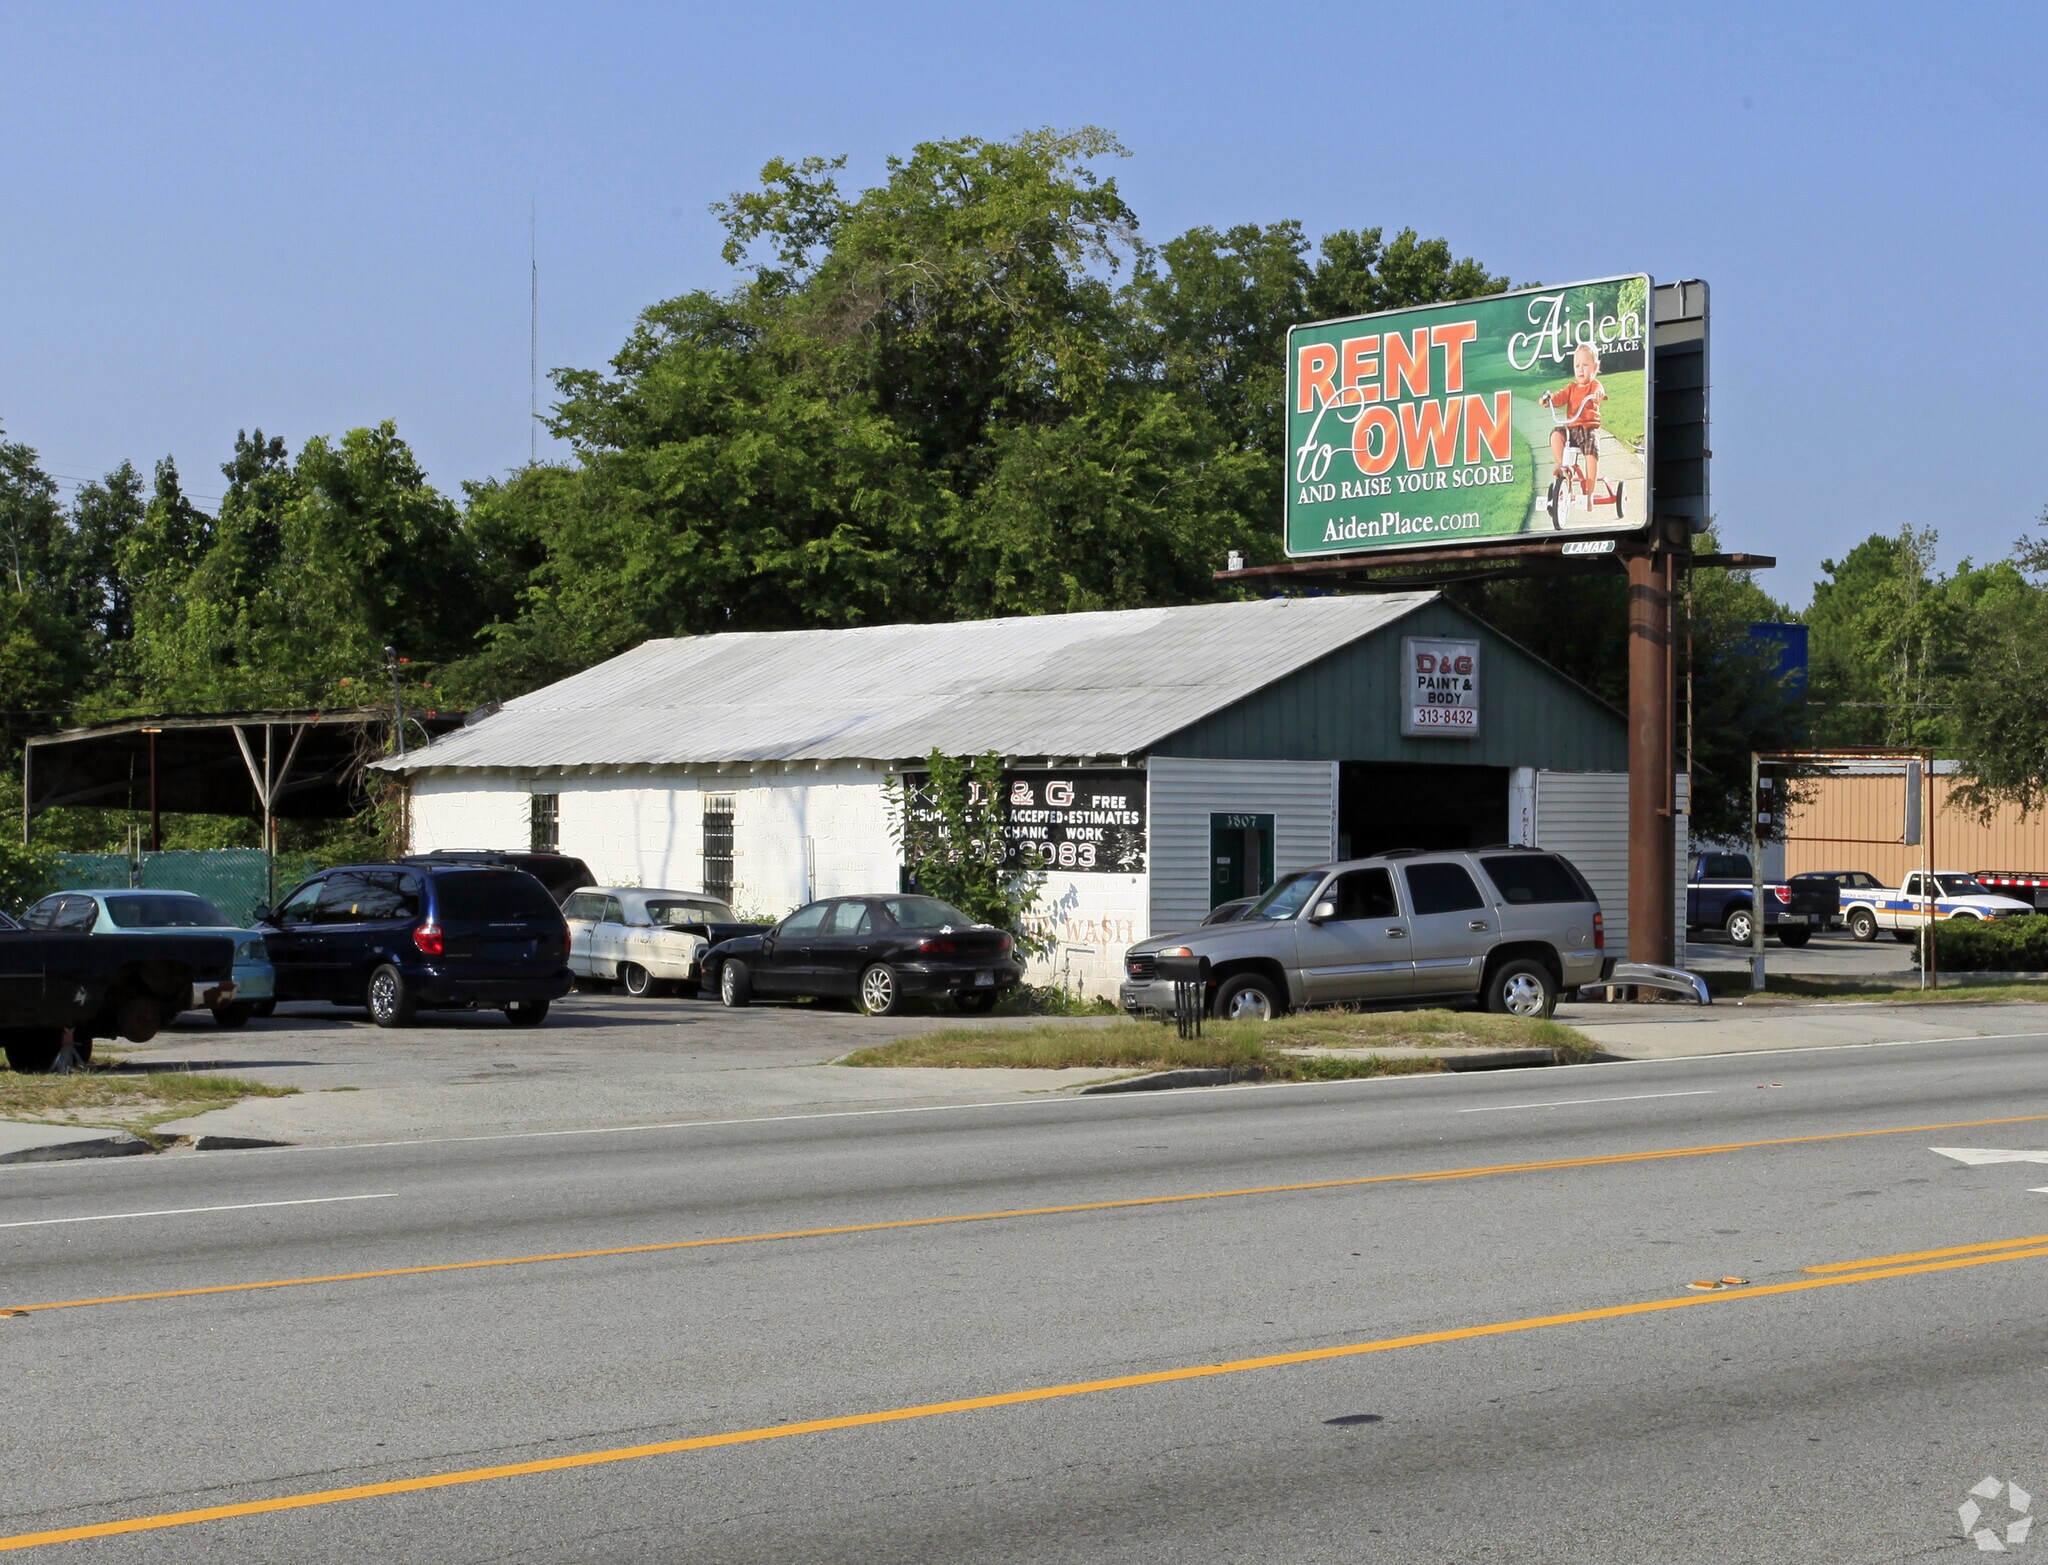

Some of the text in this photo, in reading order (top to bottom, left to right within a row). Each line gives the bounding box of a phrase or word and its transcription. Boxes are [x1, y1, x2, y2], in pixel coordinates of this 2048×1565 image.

[1508, 291, 1642, 371] Aiden
[1602, 340, 1640, 355] PLACE
[1297, 319, 1477, 414] RENT
[1296, 386, 1374, 484] to
[1351, 390, 1513, 476] OWN
[1297, 464, 1514, 505] AND RAISE YOUR SCORE
[1322, 510, 1481, 543] AidenPlace.com
[1568, 541, 1609, 554] LAMAR
[1417, 675, 1473, 691] PAINT &
[1427, 692, 1462, 705] BODY
[1418, 708, 1473, 725] 313-8432
[1010, 780, 1034, 806] &
[1045, 780, 1075, 807] G
[1091, 795, 1127, 809] FREE
[1068, 810, 1140, 825] ESTIMATES
[1065, 827, 1104, 841] WORK
[1065, 917, 1136, 945] WASH
